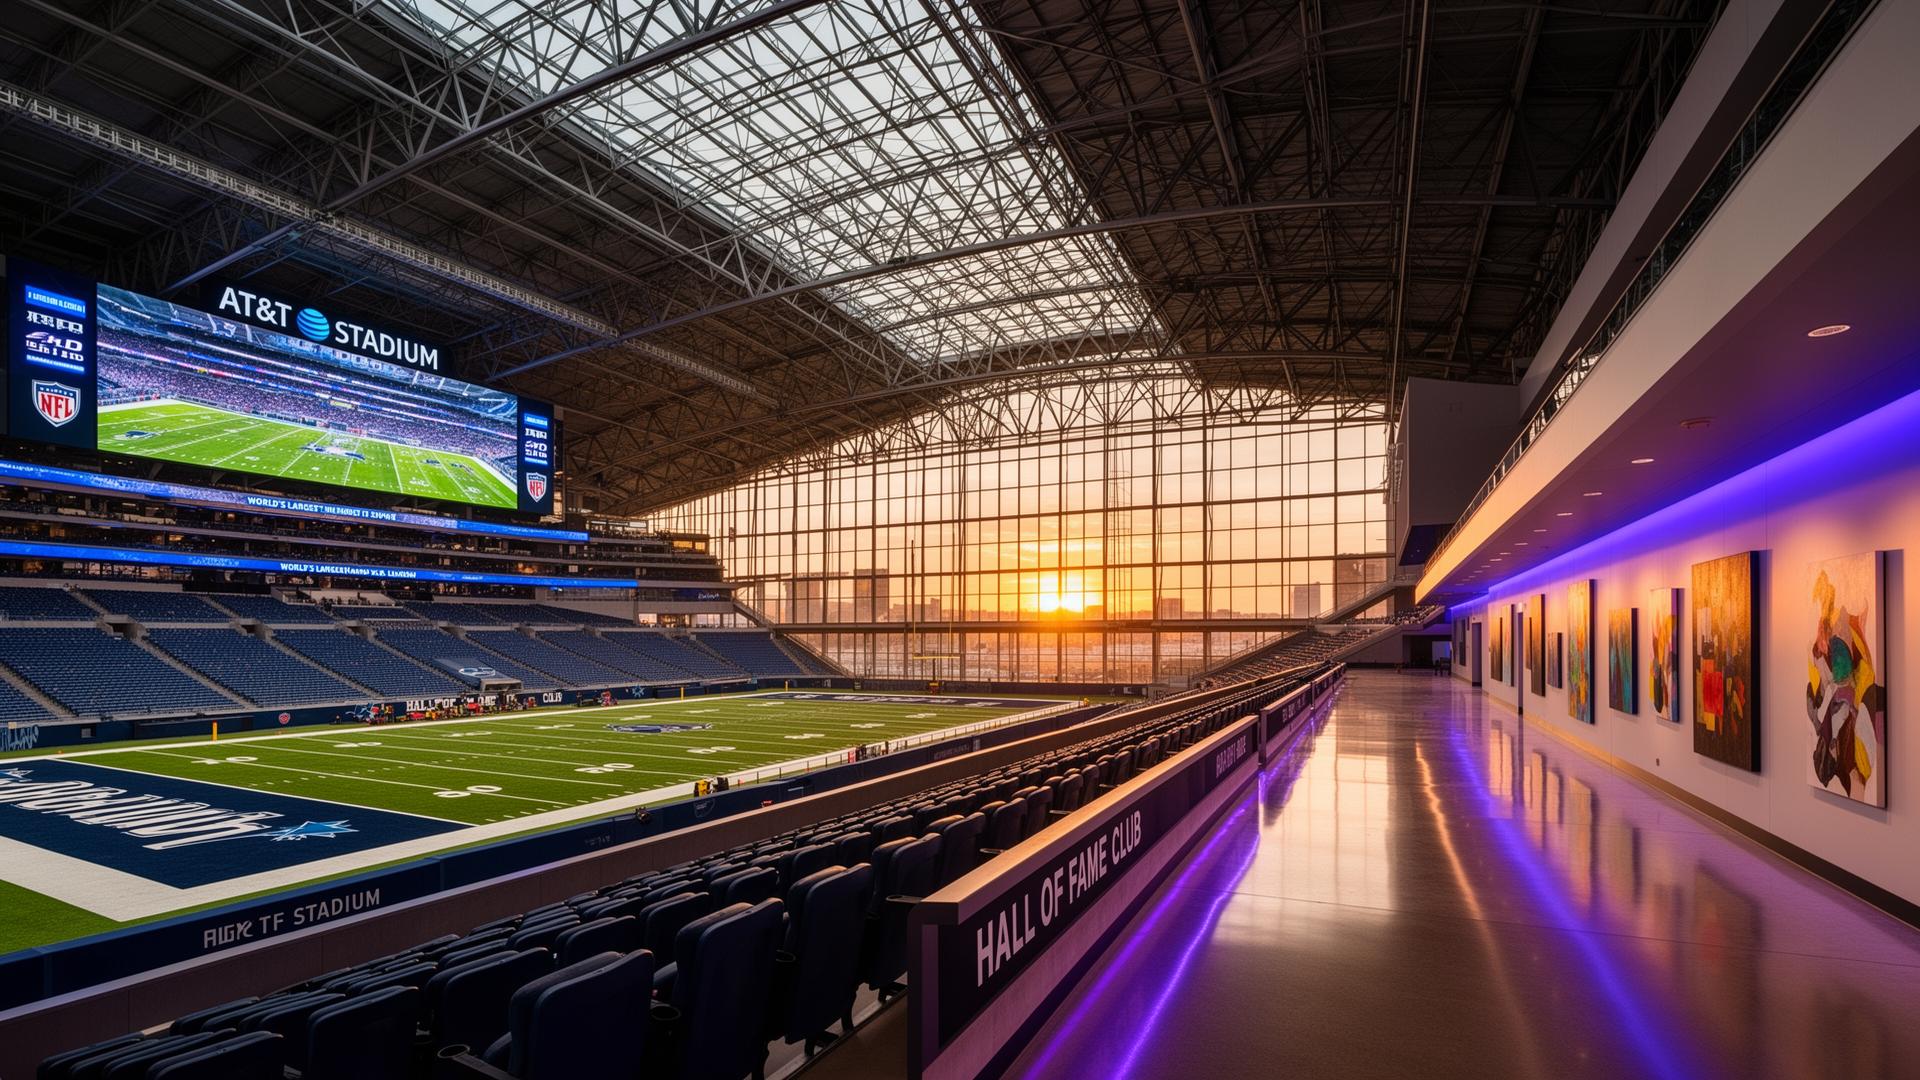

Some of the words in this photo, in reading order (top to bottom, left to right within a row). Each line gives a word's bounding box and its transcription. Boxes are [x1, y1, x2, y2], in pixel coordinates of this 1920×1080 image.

[219, 286, 292, 328] AT&T
[335, 321, 438, 370] STADIUM
[40, 393, 73, 419] NFL
[293, 888, 380, 925] STADIUM
[976, 893, 1036, 988] HALL
[1040, 866, 1064, 927] OF
[1068, 834, 1108, 905] FAME
[1111, 810, 1142, 865] CLUB
